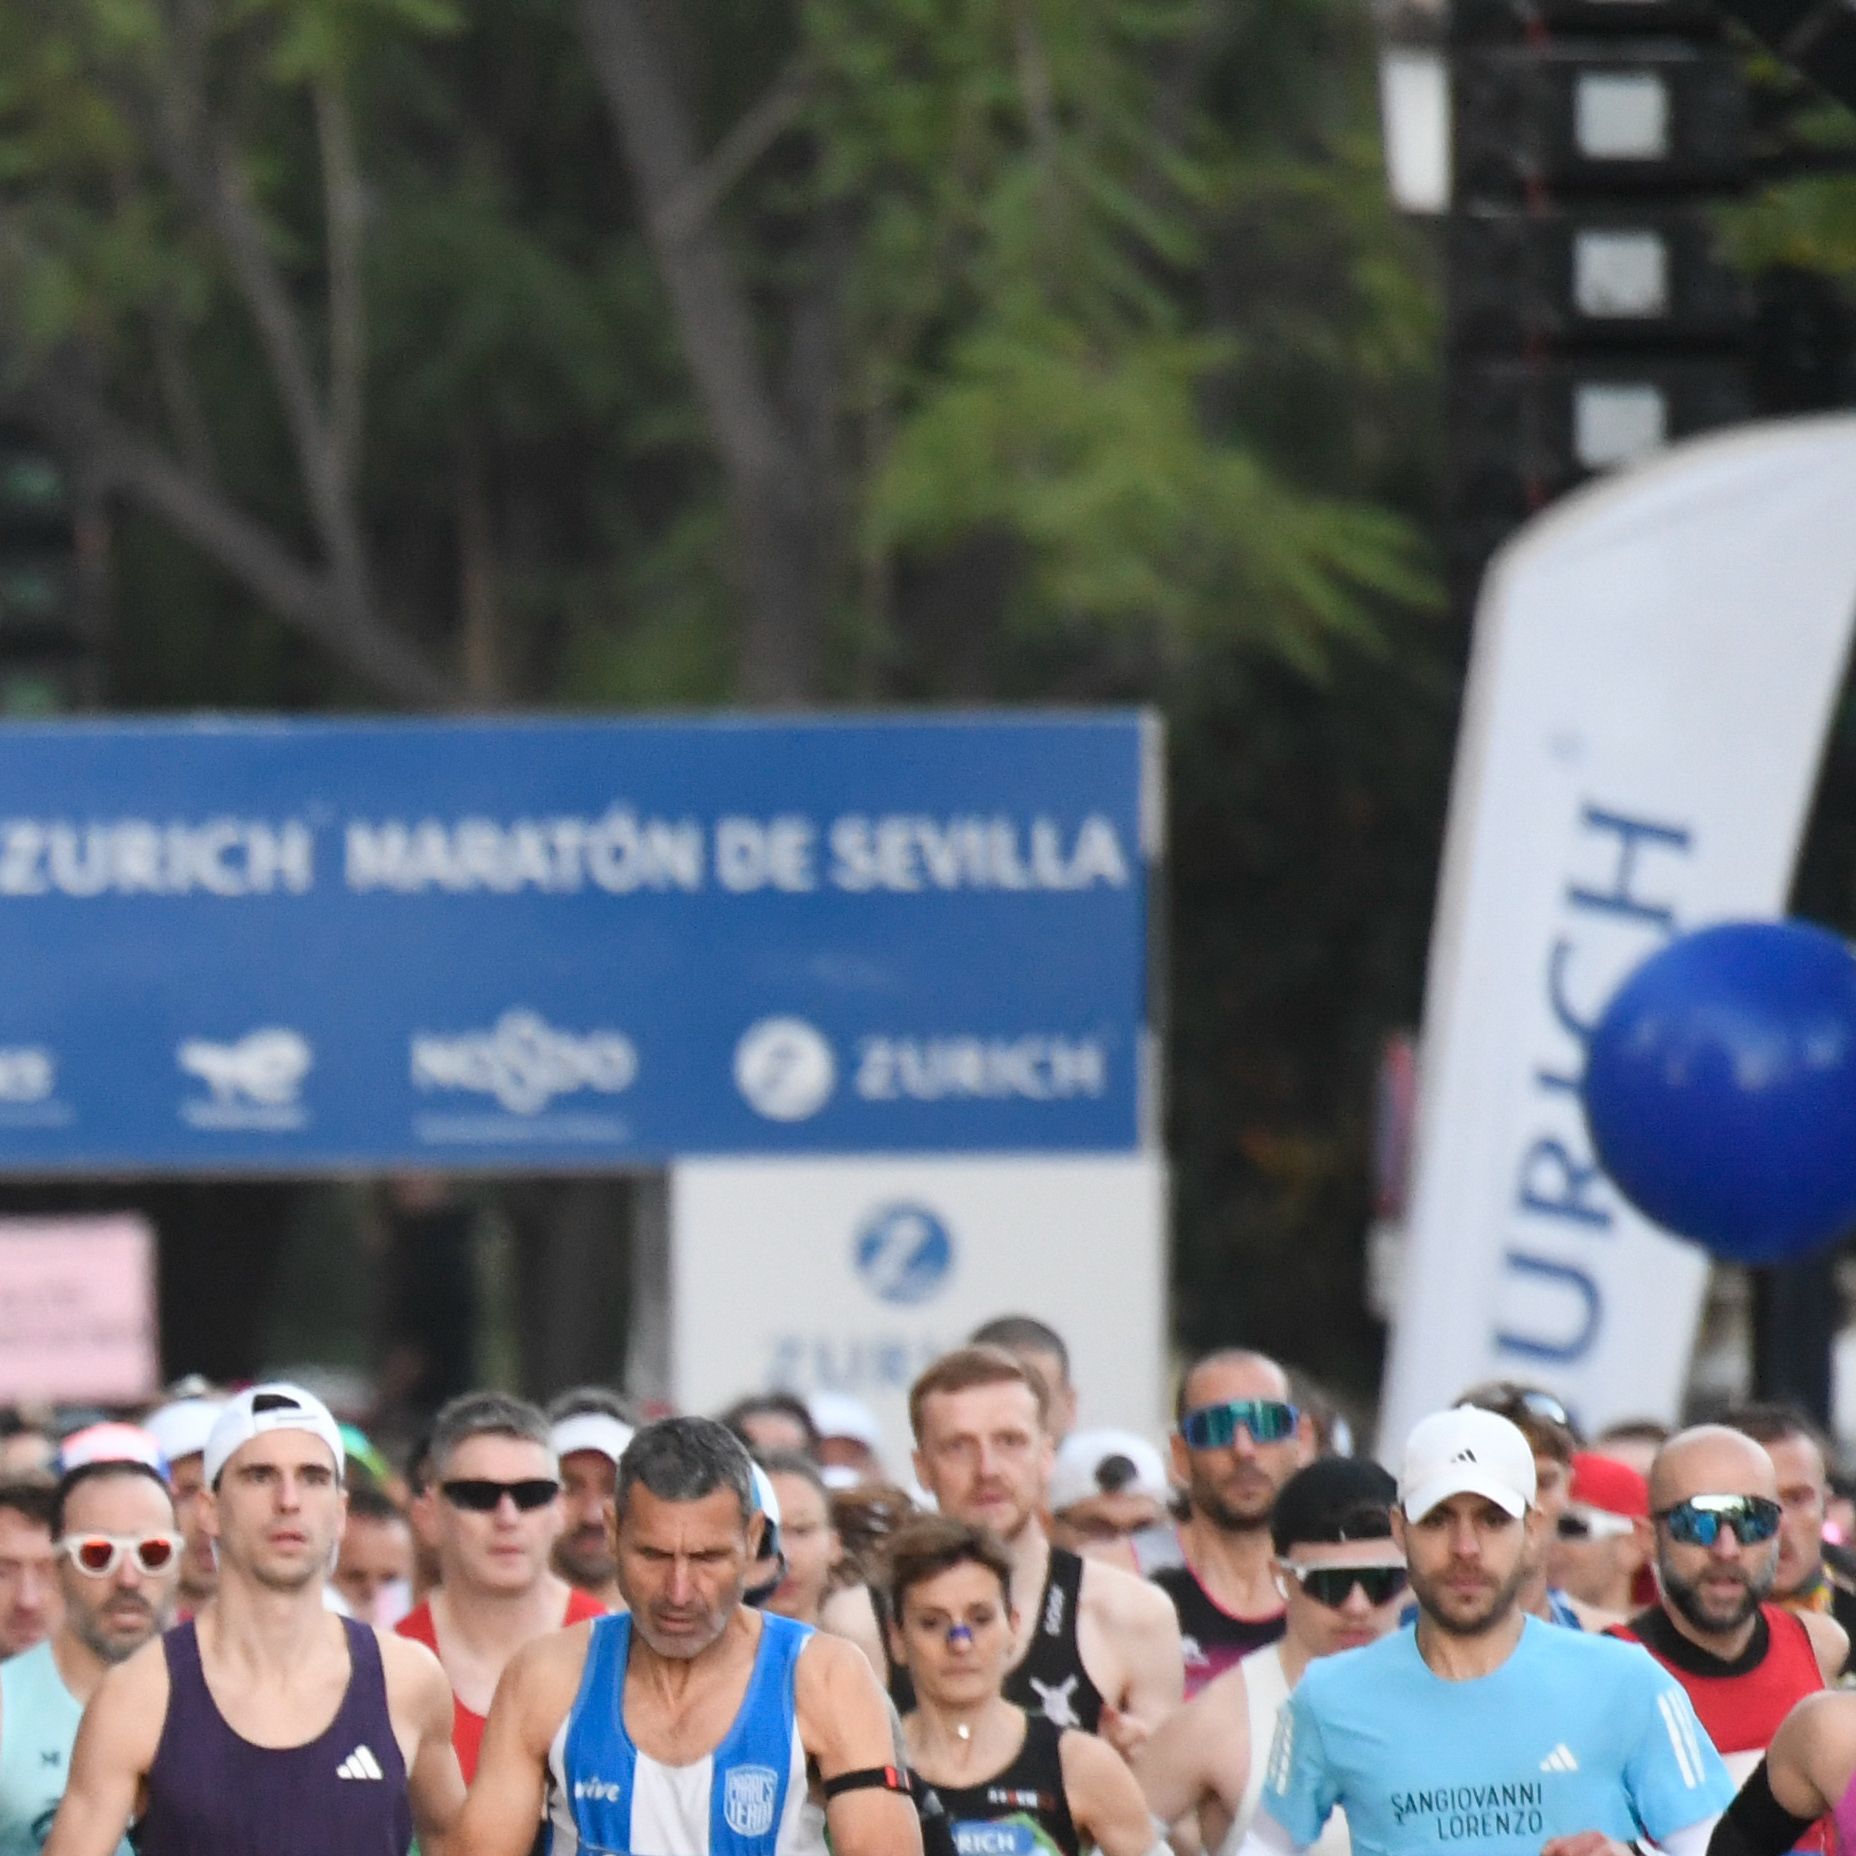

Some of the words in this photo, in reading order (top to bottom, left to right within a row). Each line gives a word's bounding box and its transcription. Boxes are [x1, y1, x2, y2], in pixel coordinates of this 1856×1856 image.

[345, 800, 704, 895] MARATÓN
[716, 814, 817, 893] DE
[828, 812, 1131, 893] SEVILLA
[856, 1034, 1108, 1102] ZURICH
[1391, 1783, 1542, 1821] SANGIOVANNI
[1438, 1810, 1543, 1840] LORENZO
